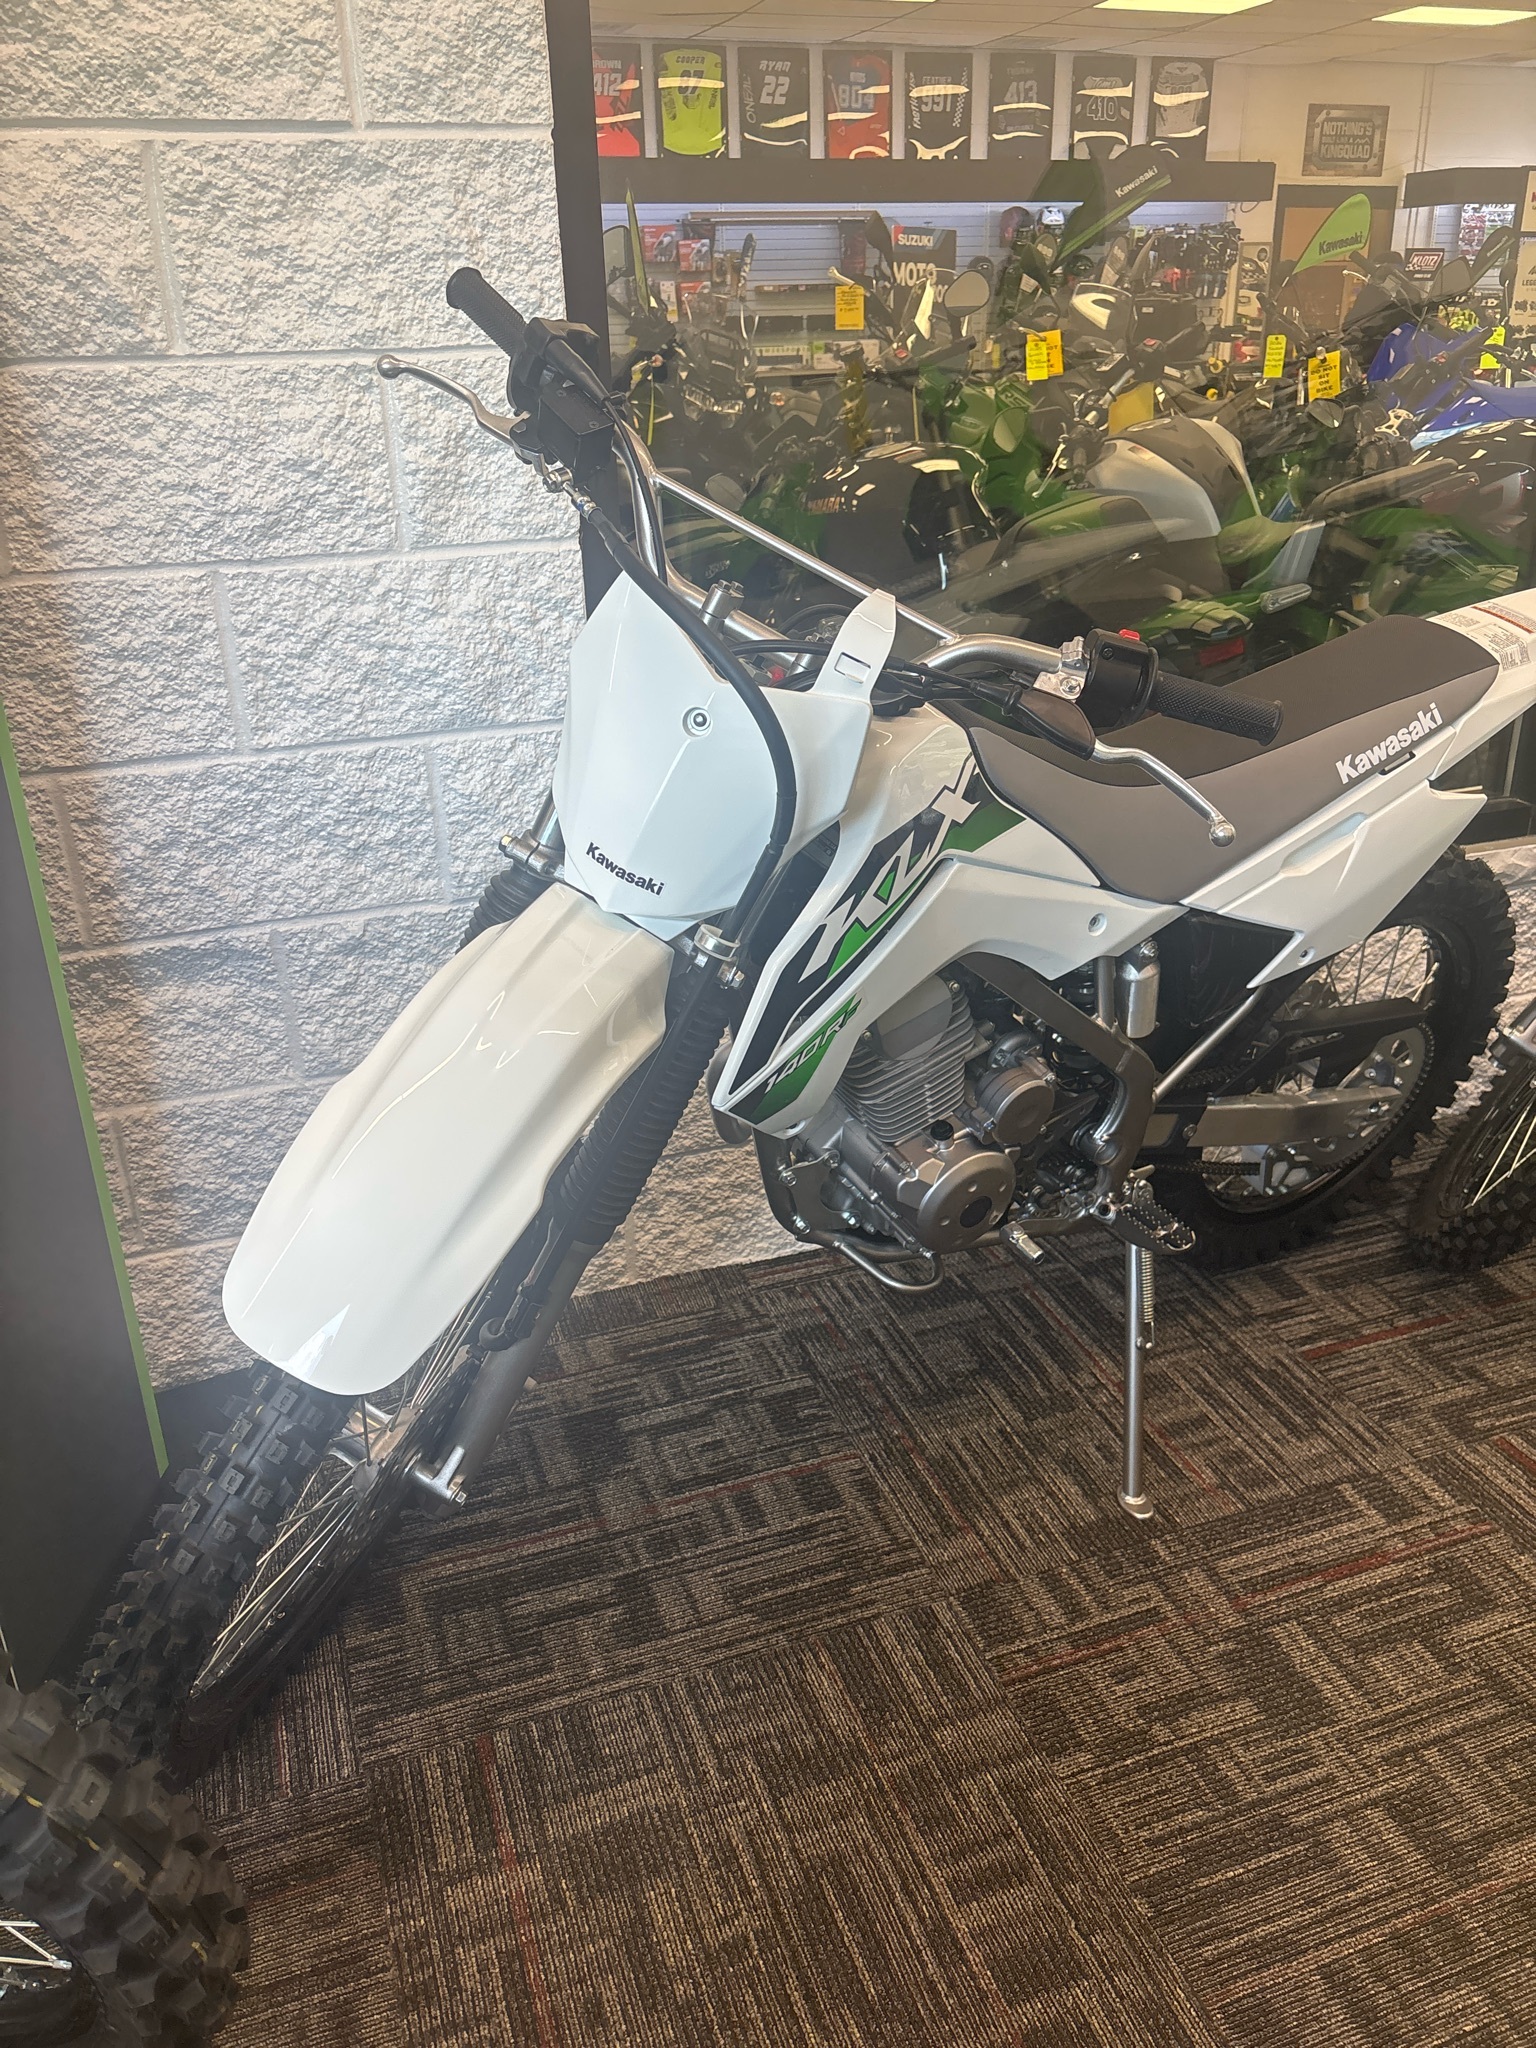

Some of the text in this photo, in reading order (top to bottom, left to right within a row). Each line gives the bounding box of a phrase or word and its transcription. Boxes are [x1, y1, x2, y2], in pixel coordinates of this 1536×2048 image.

[675, 55, 706, 65] COOPER
[758, 60, 791, 73] RYAN
[593, 72, 622, 97] 412
[759, 75, 791, 105] 22
[1003, 80, 1038, 103] 413
[1086, 96, 1118, 121] 410
[1322, 121, 1373, 136] NOTHING'S
[1319, 144, 1371, 159] KINGQUAD
[1114, 165, 1158, 198] Kawasaki
[897, 233, 934, 247] SUZUKI
[1318, 231, 1363, 256] Kawasaki
[1411, 255, 1438, 266] KLOTZ
[1322, 365, 1338, 373] NOT
[1315, 385, 1333, 393] BIKE
[1334, 702, 1444, 785] Kawasaki
[586, 841, 665, 897] Kawasaki
